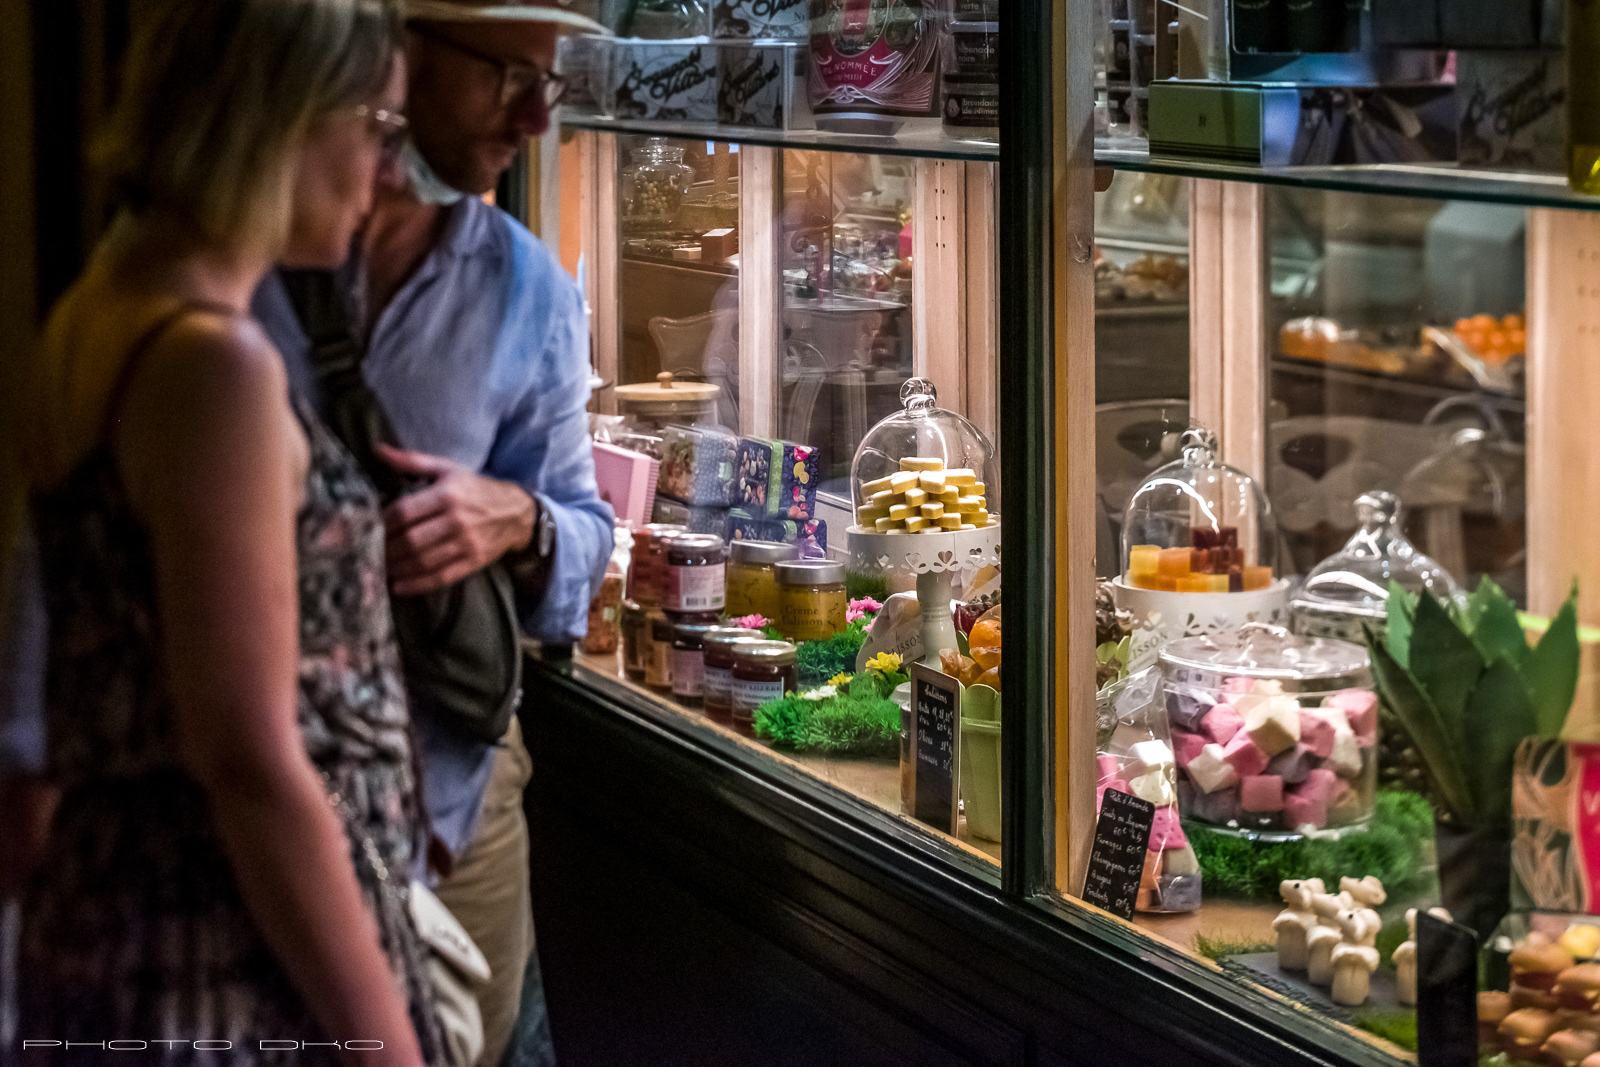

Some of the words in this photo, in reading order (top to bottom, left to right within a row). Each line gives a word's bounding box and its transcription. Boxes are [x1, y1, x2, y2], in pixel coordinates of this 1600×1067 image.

[959, 44, 996, 57] penade
[843, 73, 863, 81] MIDI
[782, 614, 823, 626] Calisson
